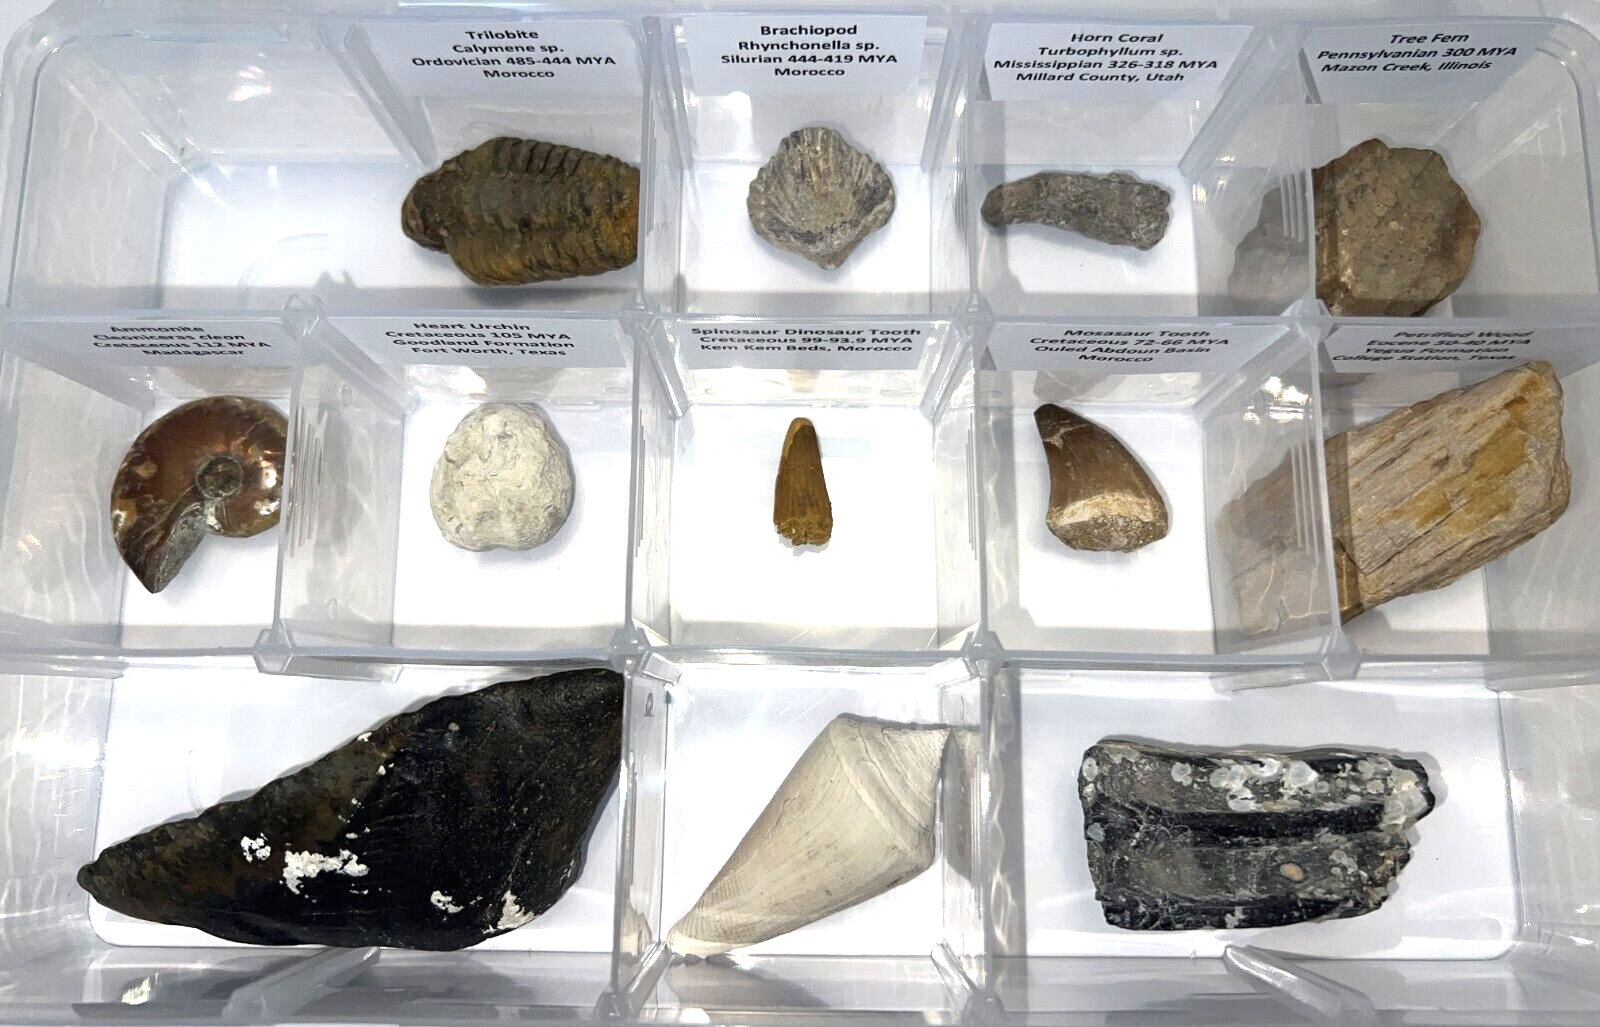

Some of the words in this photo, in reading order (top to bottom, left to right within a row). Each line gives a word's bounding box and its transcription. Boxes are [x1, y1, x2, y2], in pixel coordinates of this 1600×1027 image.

[465, 31, 539, 40] Trilobite
[760, 25, 857, 37] Brachiopod
[1071, 34, 1113, 43] Horn
[1118, 34, 1164, 43] Coral
[1390, 35, 1428, 44] Tree
[1431, 34, 1470, 43] Fern
[453, 44, 535, 54] Calymene
[540, 45, 564, 54] sp.
[738, 41, 851, 51] Rhynchonella
[856, 42, 880, 51] sp.
[1039, 47, 1156, 57] Turbophyllum
[1159, 49, 1183, 57] sp.
[1317, 50, 1438, 60] Pennsylvanian
[1441, 49, 1474, 57] 300
[1476, 48, 1518, 56] MYA
[412, 58, 501, 66] Ordovician
[506, 57, 572, 65] 485-444
[721, 55, 783, 63] Silurian
[787, 55, 854, 63] 444-419
[994, 60, 1103, 70] Mississippian
[1320, 64, 1378, 72] Mazon
[1382, 63, 1432, 71] Creek,
[1437, 61, 1493, 70] Illinois
[483, 70, 555, 78] Morocco
[774, 68, 845, 76] Morocco
[1016, 73, 1075, 81] Millard
[1079, 73, 1140, 82] County,
[691, 328, 780, 336] Spinosaur
